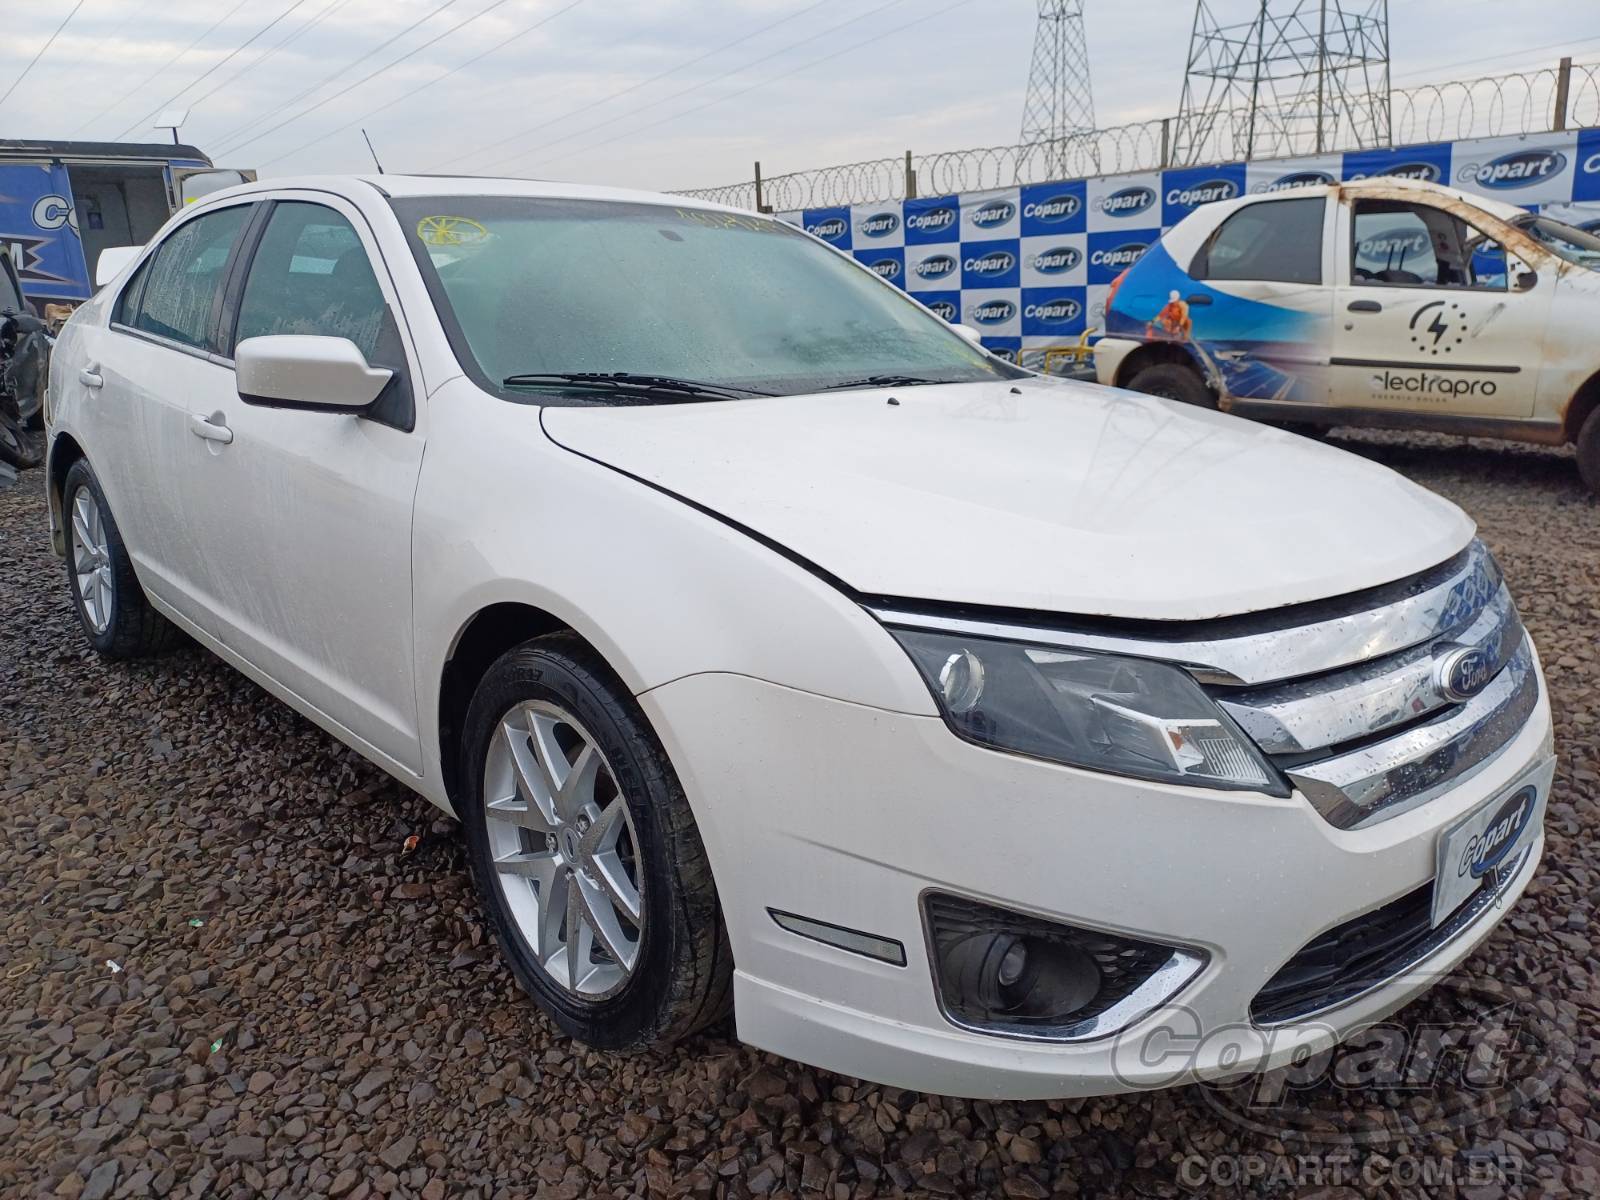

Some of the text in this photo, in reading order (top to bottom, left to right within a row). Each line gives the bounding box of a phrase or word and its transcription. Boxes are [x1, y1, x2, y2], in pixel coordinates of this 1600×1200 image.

[1457, 152, 1551, 183] Copart
[1091, 191, 1148, 211] Copart
[1166, 184, 1231, 206] Copart
[1024, 199, 1075, 218] Copart
[907, 210, 951, 229] Copart
[806, 222, 843, 237] Copart
[964, 256, 1010, 273] Copart
[1024, 252, 1075, 270] Copart
[967, 304, 1010, 320] Copart
[1024, 302, 1075, 320] Copart
[1461, 655, 1488, 690] Ford
[1458, 797, 1526, 878] Copart
